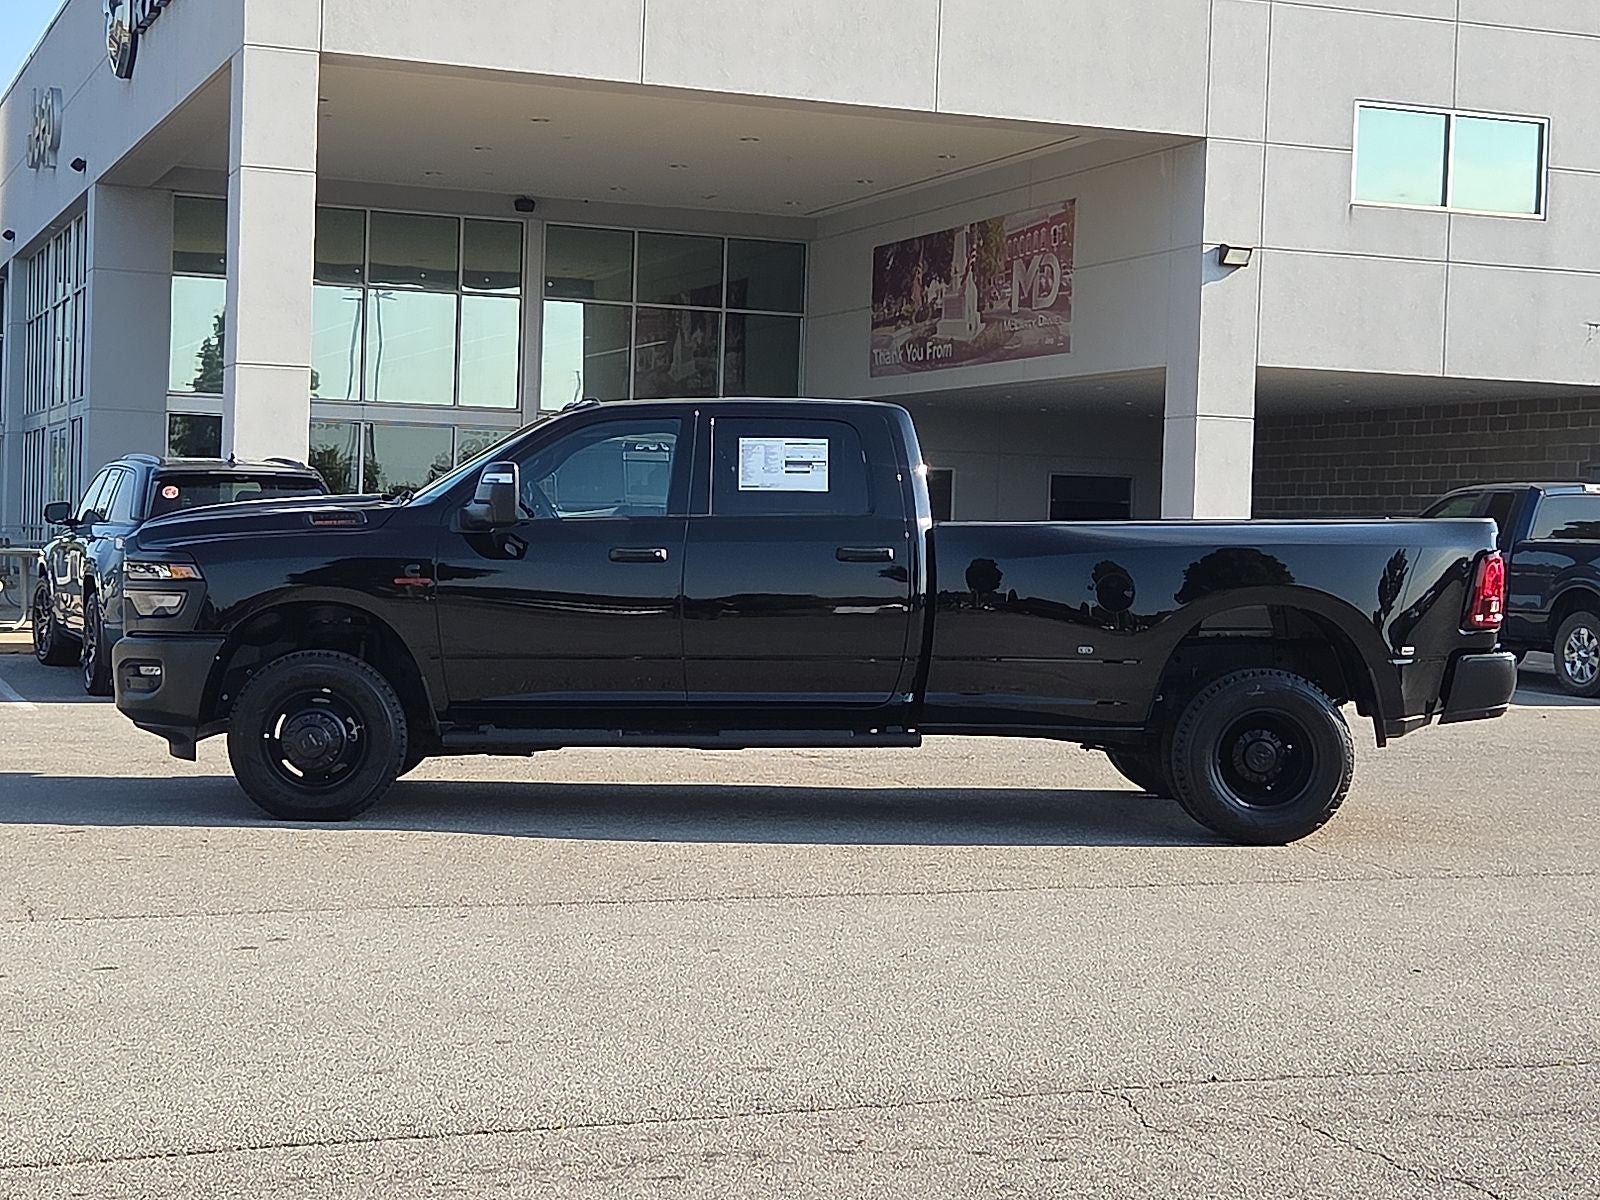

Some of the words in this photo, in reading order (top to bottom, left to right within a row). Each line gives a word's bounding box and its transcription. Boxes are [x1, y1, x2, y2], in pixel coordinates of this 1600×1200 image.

[873, 348, 903, 366] Thank
[905, 342, 924, 362] You
[926, 341, 953, 361] From
